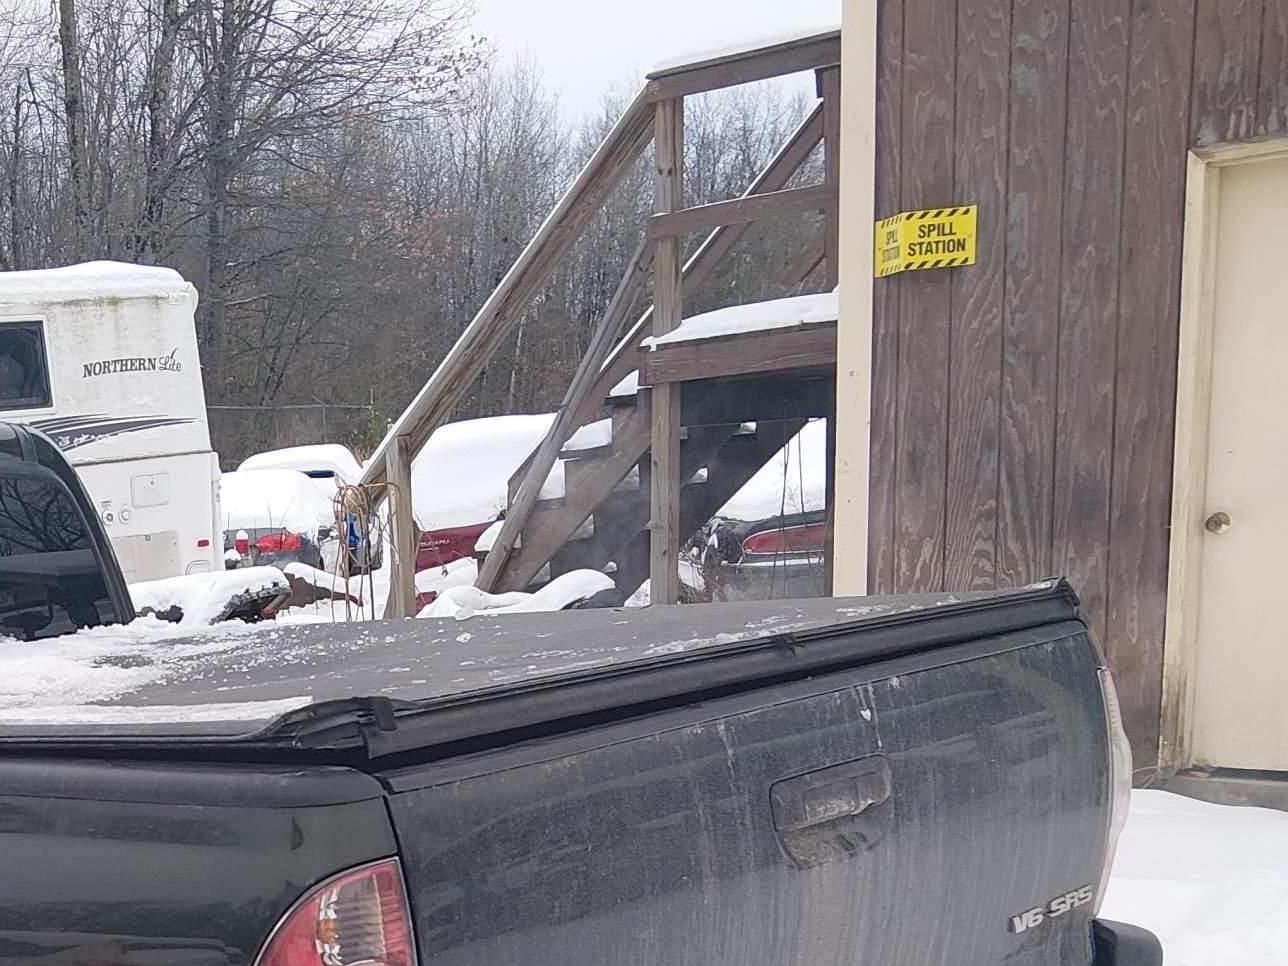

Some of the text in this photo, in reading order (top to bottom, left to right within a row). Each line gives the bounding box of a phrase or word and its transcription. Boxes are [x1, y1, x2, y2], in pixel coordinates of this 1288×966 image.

[918, 222, 957, 239] SPILL
[907, 238, 967, 257] STATION
[82, 349, 182, 378] NORTHERN Lite
[1012, 906, 1044, 934] V6
